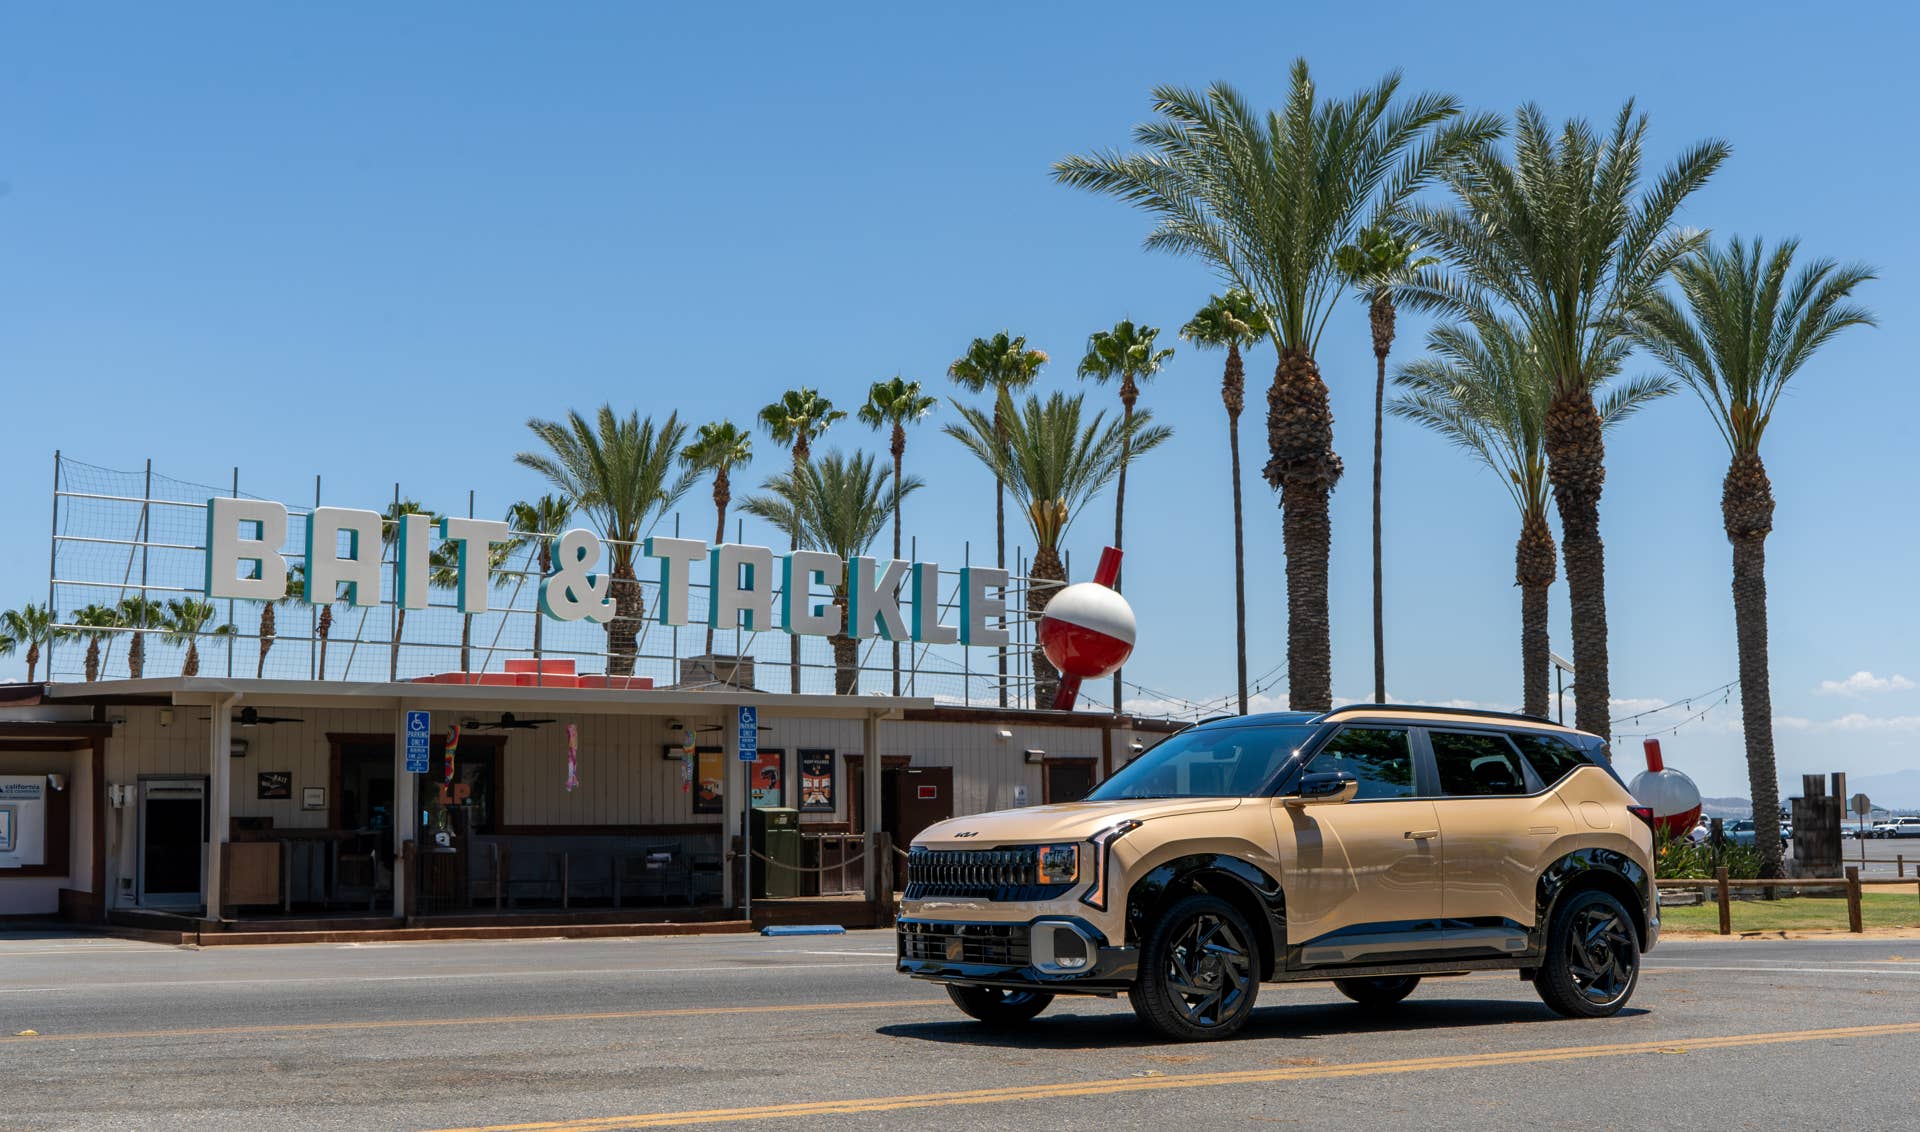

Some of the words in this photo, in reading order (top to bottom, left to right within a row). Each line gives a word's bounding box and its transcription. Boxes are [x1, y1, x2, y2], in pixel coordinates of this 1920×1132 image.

[205, 497, 509, 614] BAIT
[538, 528, 617, 624] &
[643, 536, 1010, 647] TACKLE
